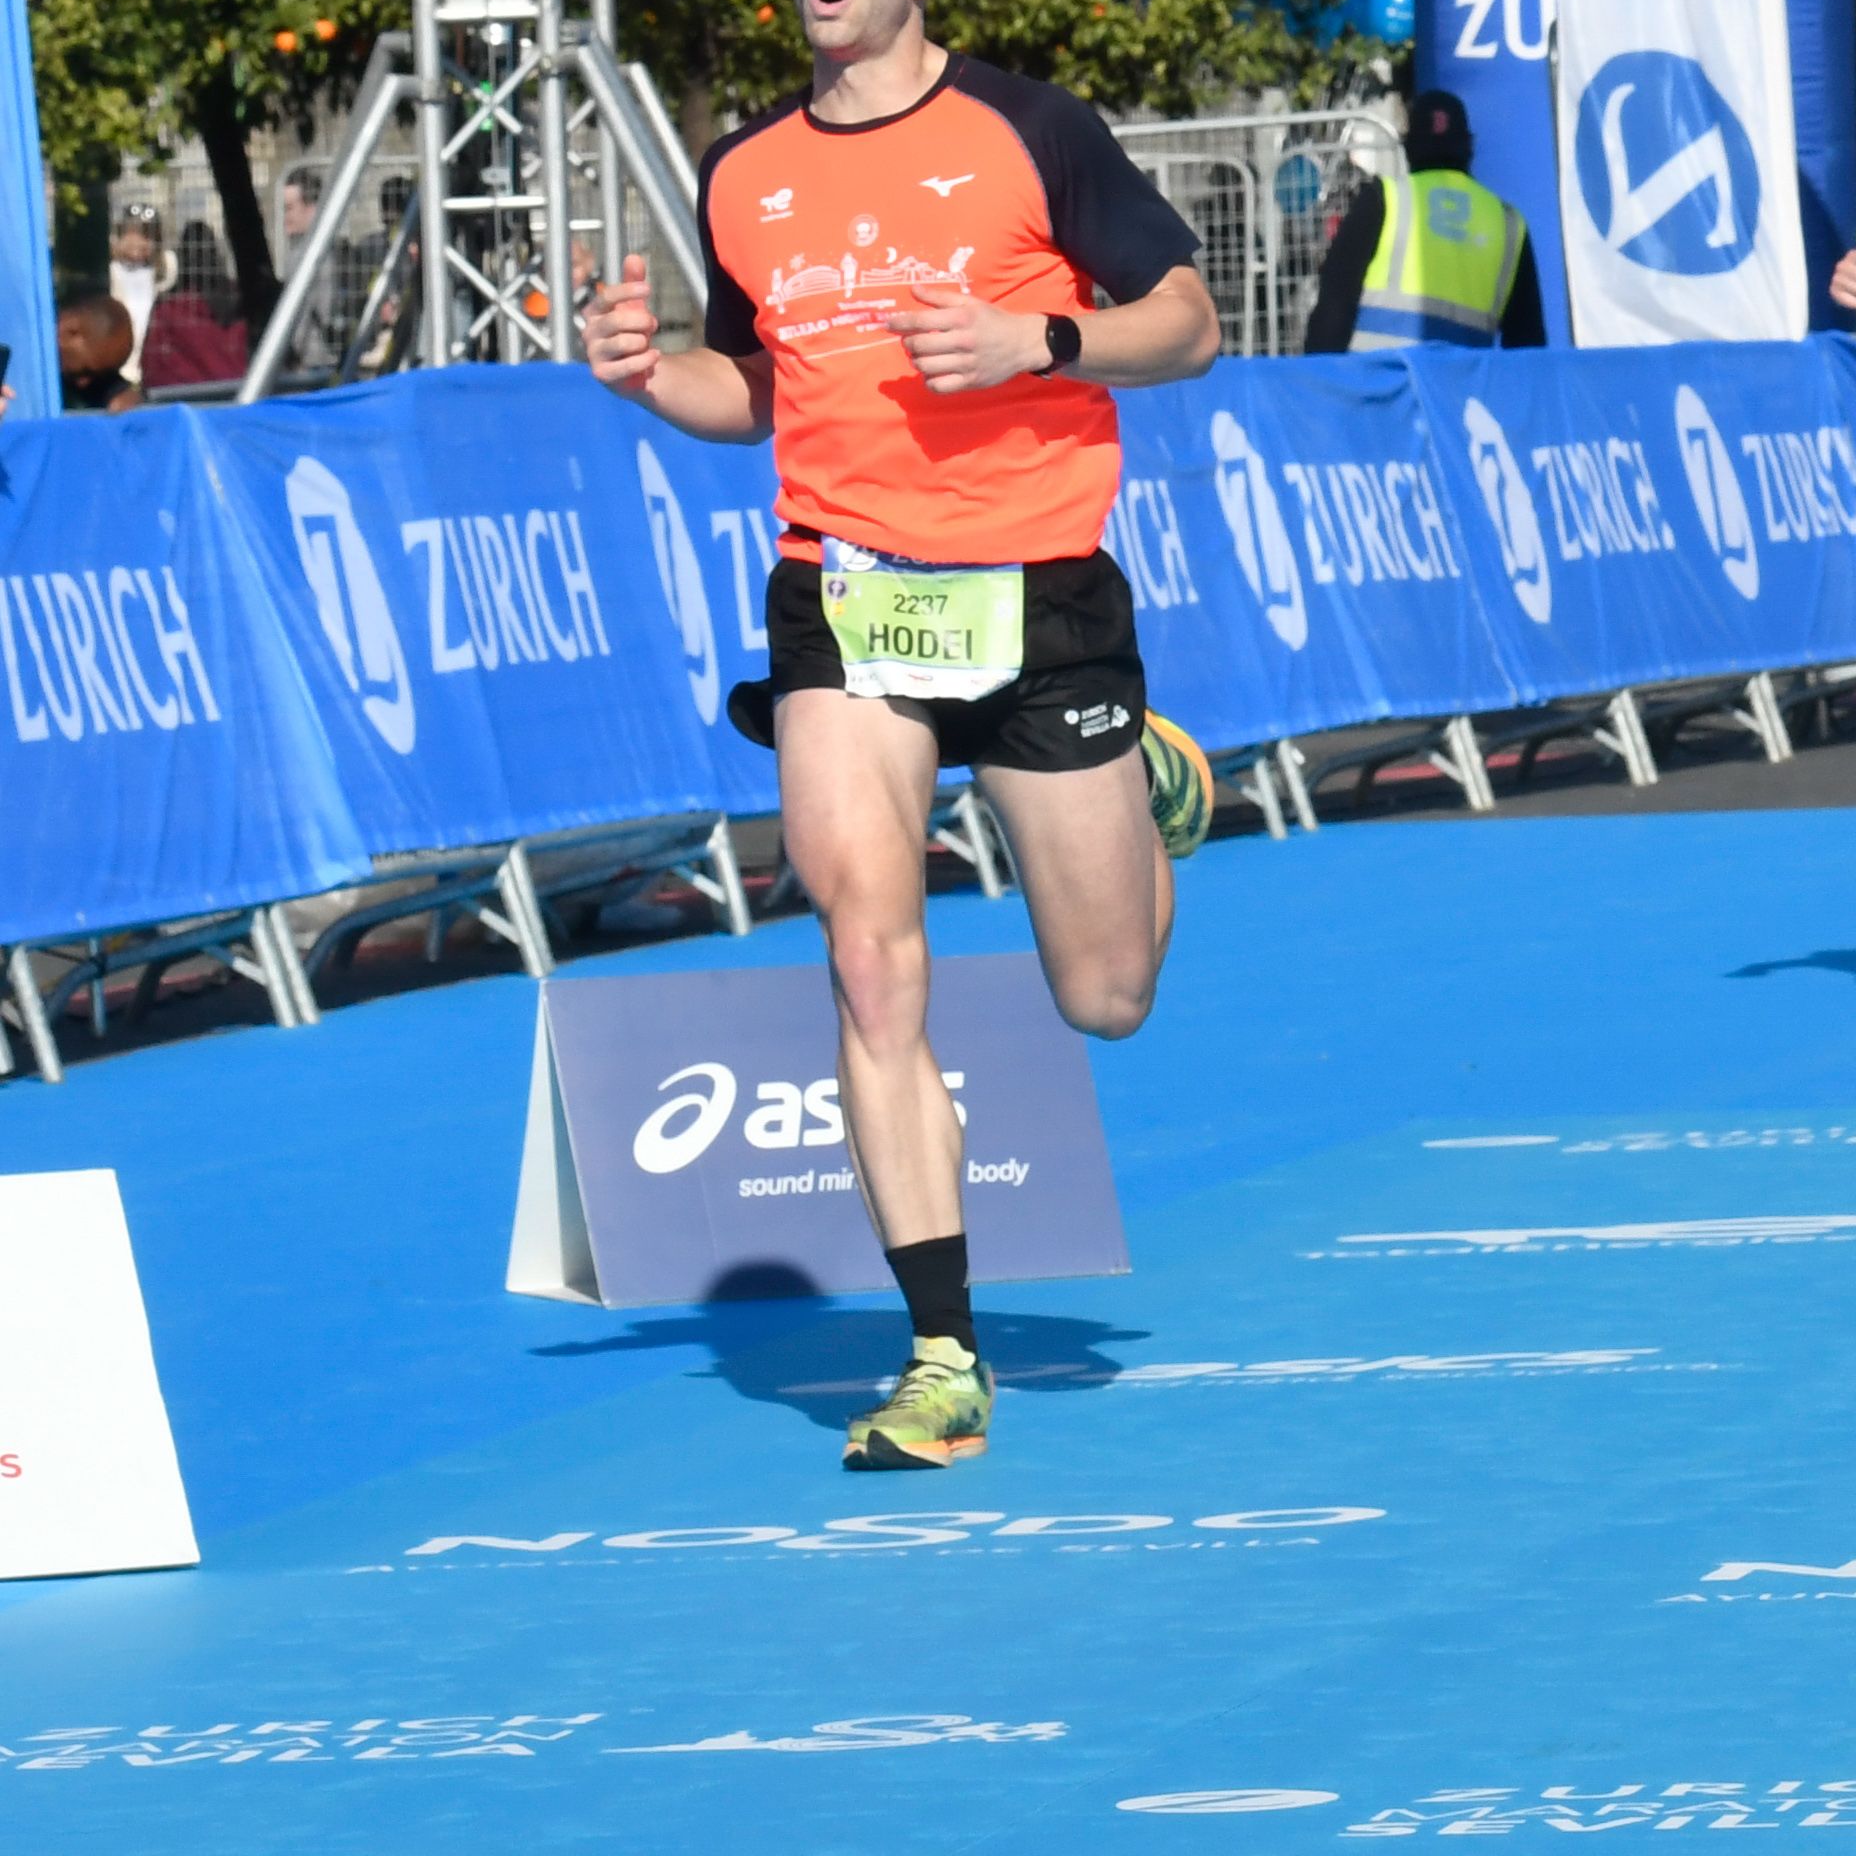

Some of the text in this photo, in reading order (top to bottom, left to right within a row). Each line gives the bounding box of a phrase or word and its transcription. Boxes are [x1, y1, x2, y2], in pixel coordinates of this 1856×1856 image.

[1284, 461, 1460, 586] ZURICH
[402, 508, 611, 674] ZURICH
[893, 594, 948, 616] 2237
[869, 623, 973, 661] HODEI
[738, 1169, 813, 1198] sound
[967, 1158, 1030, 1191] body
[18, 1712, 605, 1741] ZURICH
[0, 1742, 537, 1770] EVILLA
